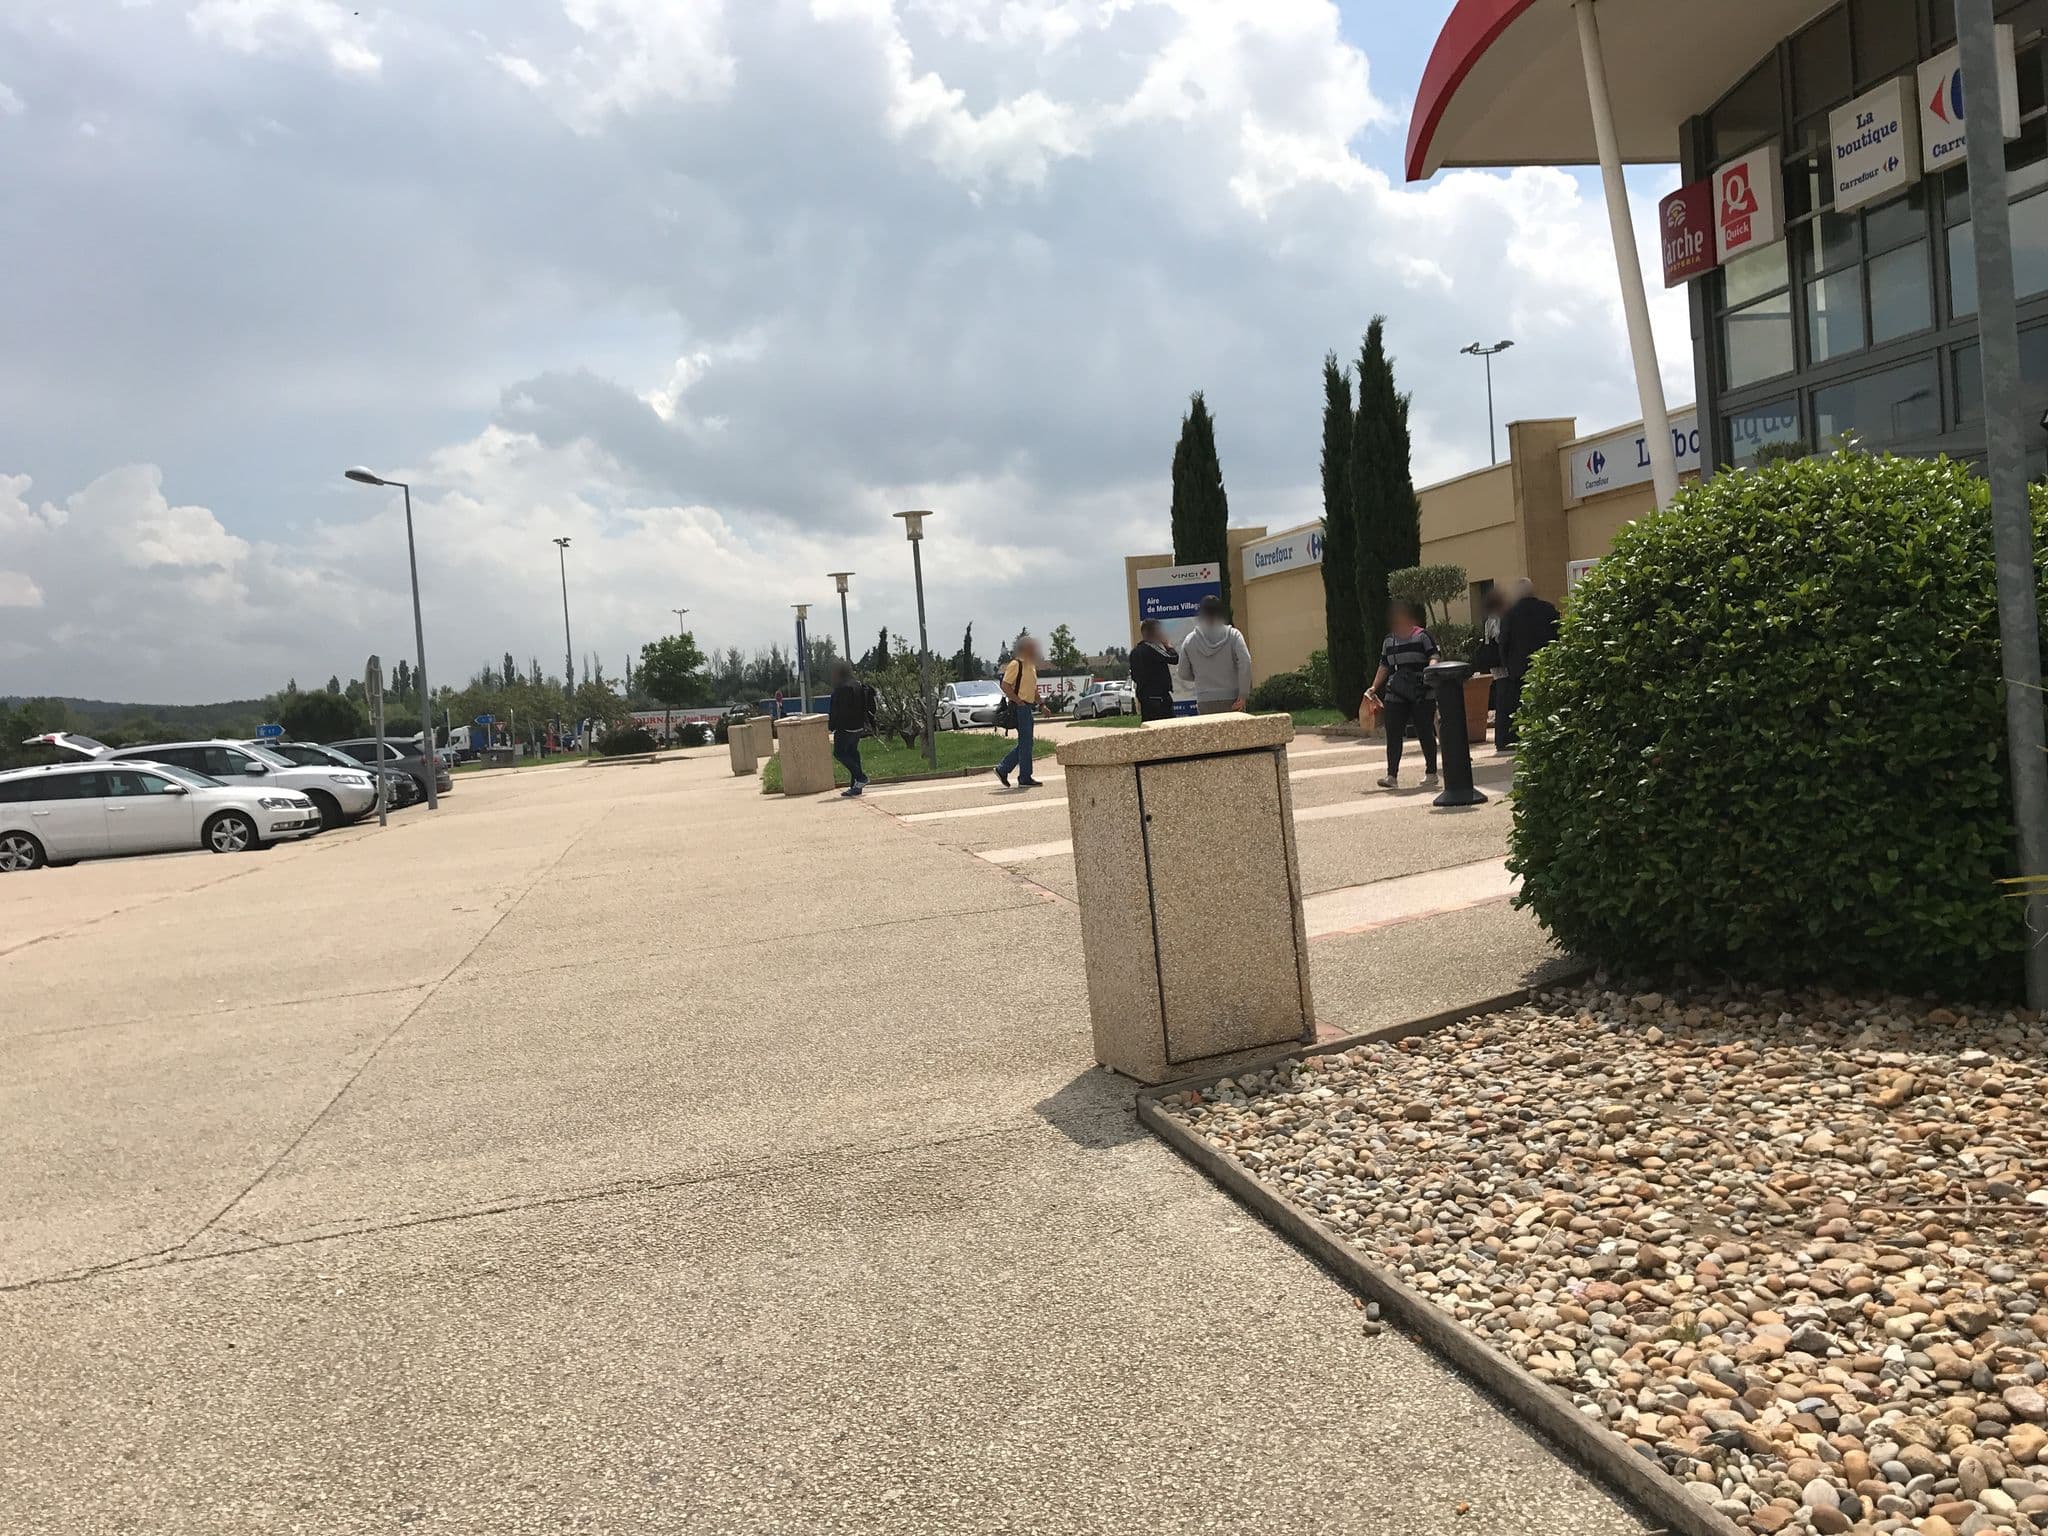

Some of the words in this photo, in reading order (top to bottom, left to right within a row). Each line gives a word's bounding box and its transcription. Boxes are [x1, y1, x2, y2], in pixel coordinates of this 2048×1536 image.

[1856, 111, 1875, 130] La
[1836, 120, 1898, 159] boutique
[1932, 135, 1967, 158] Carre
[1839, 167, 1880, 192] Carrefour
[1726, 223, 1750, 241] Quick
[1254, 546, 1293, 568] Carrefour
[1146, 597, 1160, 605] Aire
[1156, 604, 1180, 612] Mornas
